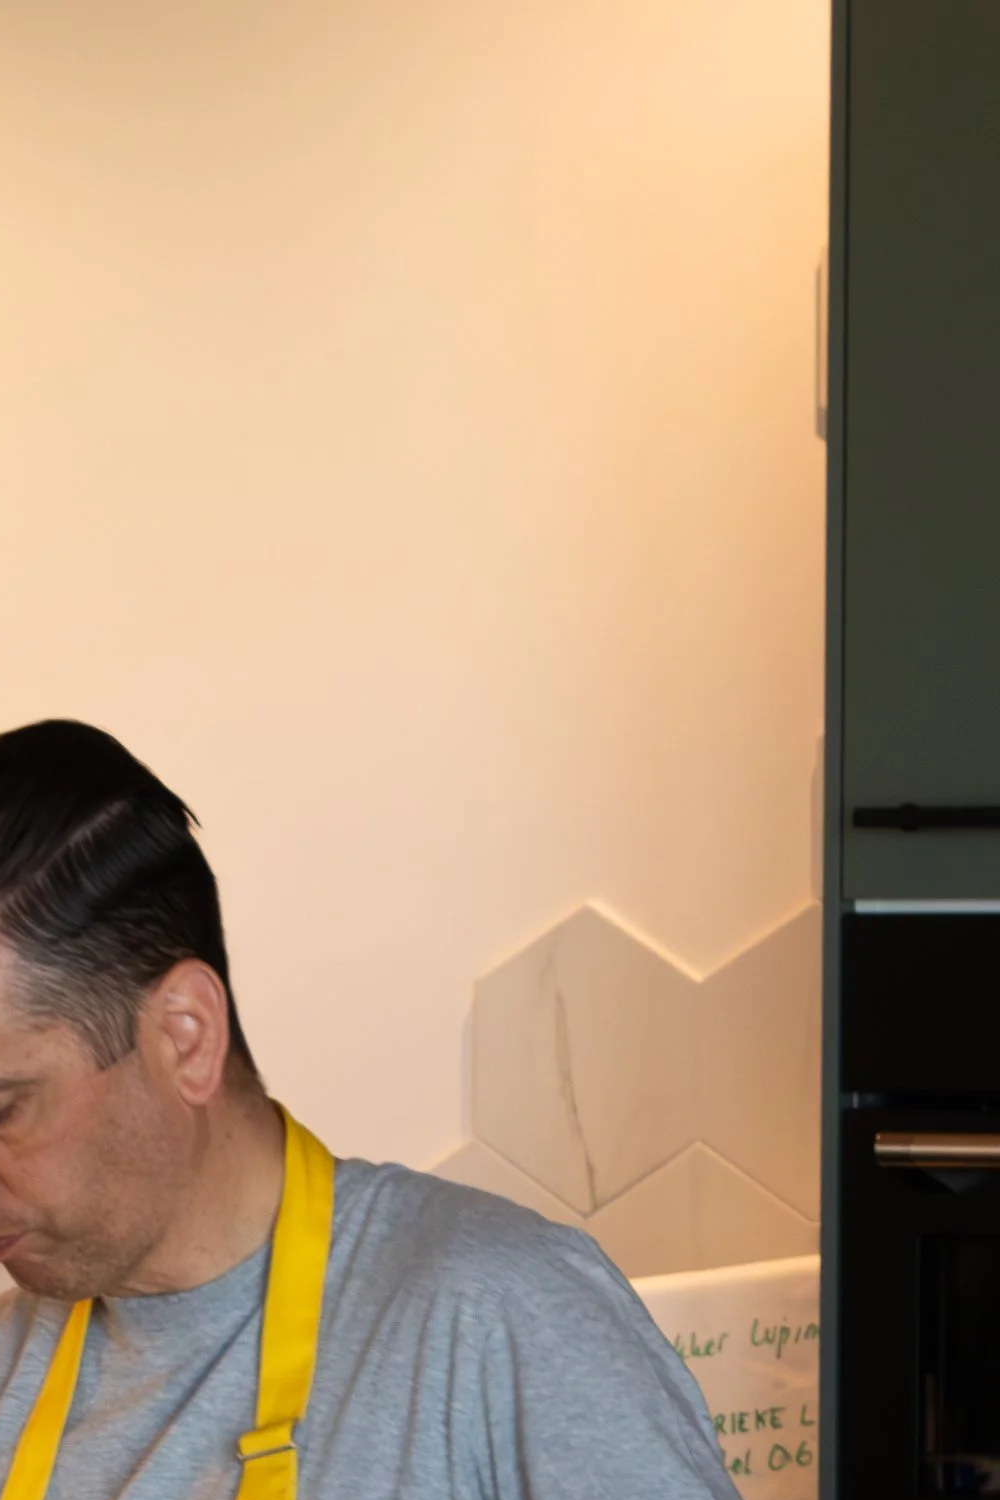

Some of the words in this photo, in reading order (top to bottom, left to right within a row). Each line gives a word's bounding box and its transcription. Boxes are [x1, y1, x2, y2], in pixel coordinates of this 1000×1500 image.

[750, 1315, 820, 1360] Lupin
[713, 1406, 786, 1435] RIEKE
[727, 1448, 752, 1475] el
[767, 1440, 813, 1472] 06
